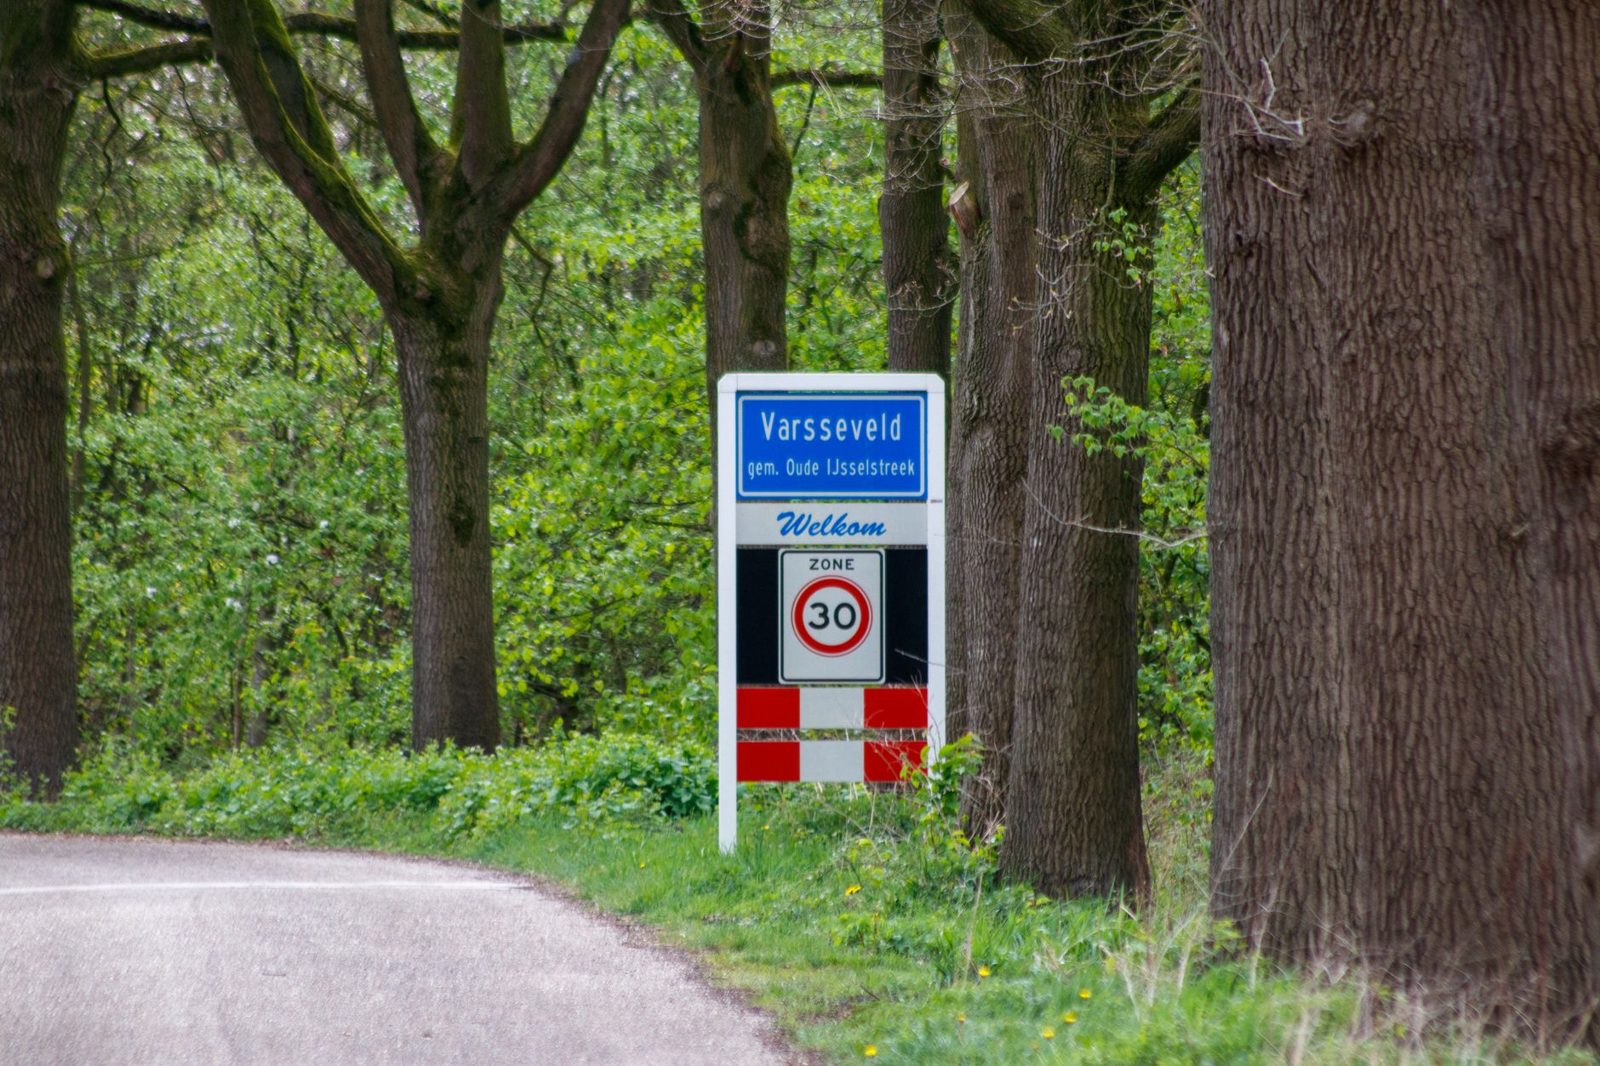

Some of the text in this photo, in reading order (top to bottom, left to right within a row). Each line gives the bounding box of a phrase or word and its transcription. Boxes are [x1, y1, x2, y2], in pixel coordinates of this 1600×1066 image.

[761, 411, 901, 441] Varsseveld
[748, 458, 915, 479] gem. Oude IJsselstreek
[776, 511, 887, 537] Welkom
[809, 558, 856, 571] ZONE
[808, 602, 857, 630] 30
